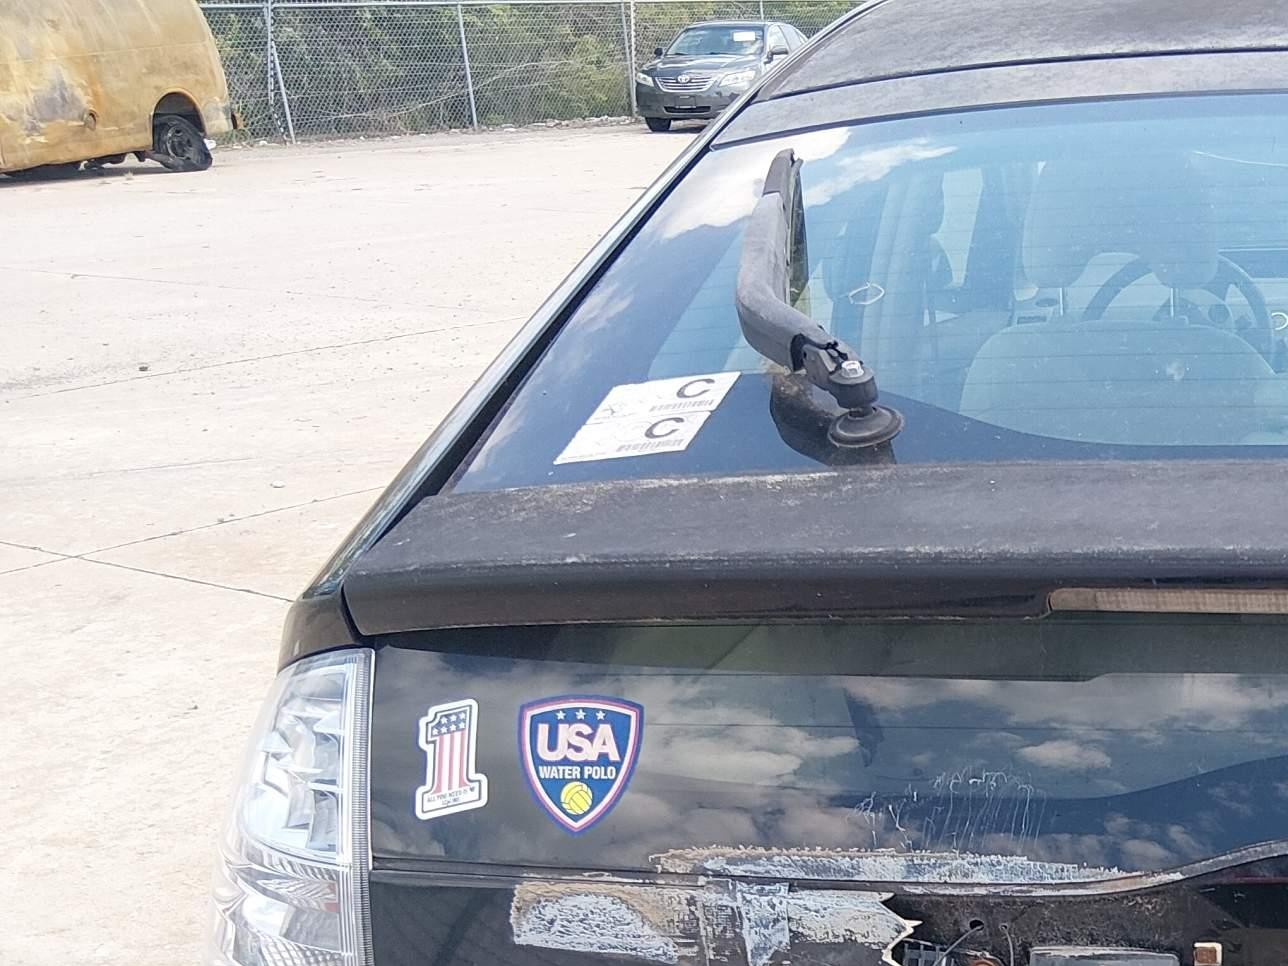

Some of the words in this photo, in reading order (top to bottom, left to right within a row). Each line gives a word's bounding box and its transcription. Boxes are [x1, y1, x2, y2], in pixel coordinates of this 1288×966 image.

[676, 378, 715, 399] C
[644, 417, 685, 439] C
[536, 723, 621, 762] USA
[539, 765, 581, 780] WATER
[584, 765, 617, 780] POLO
